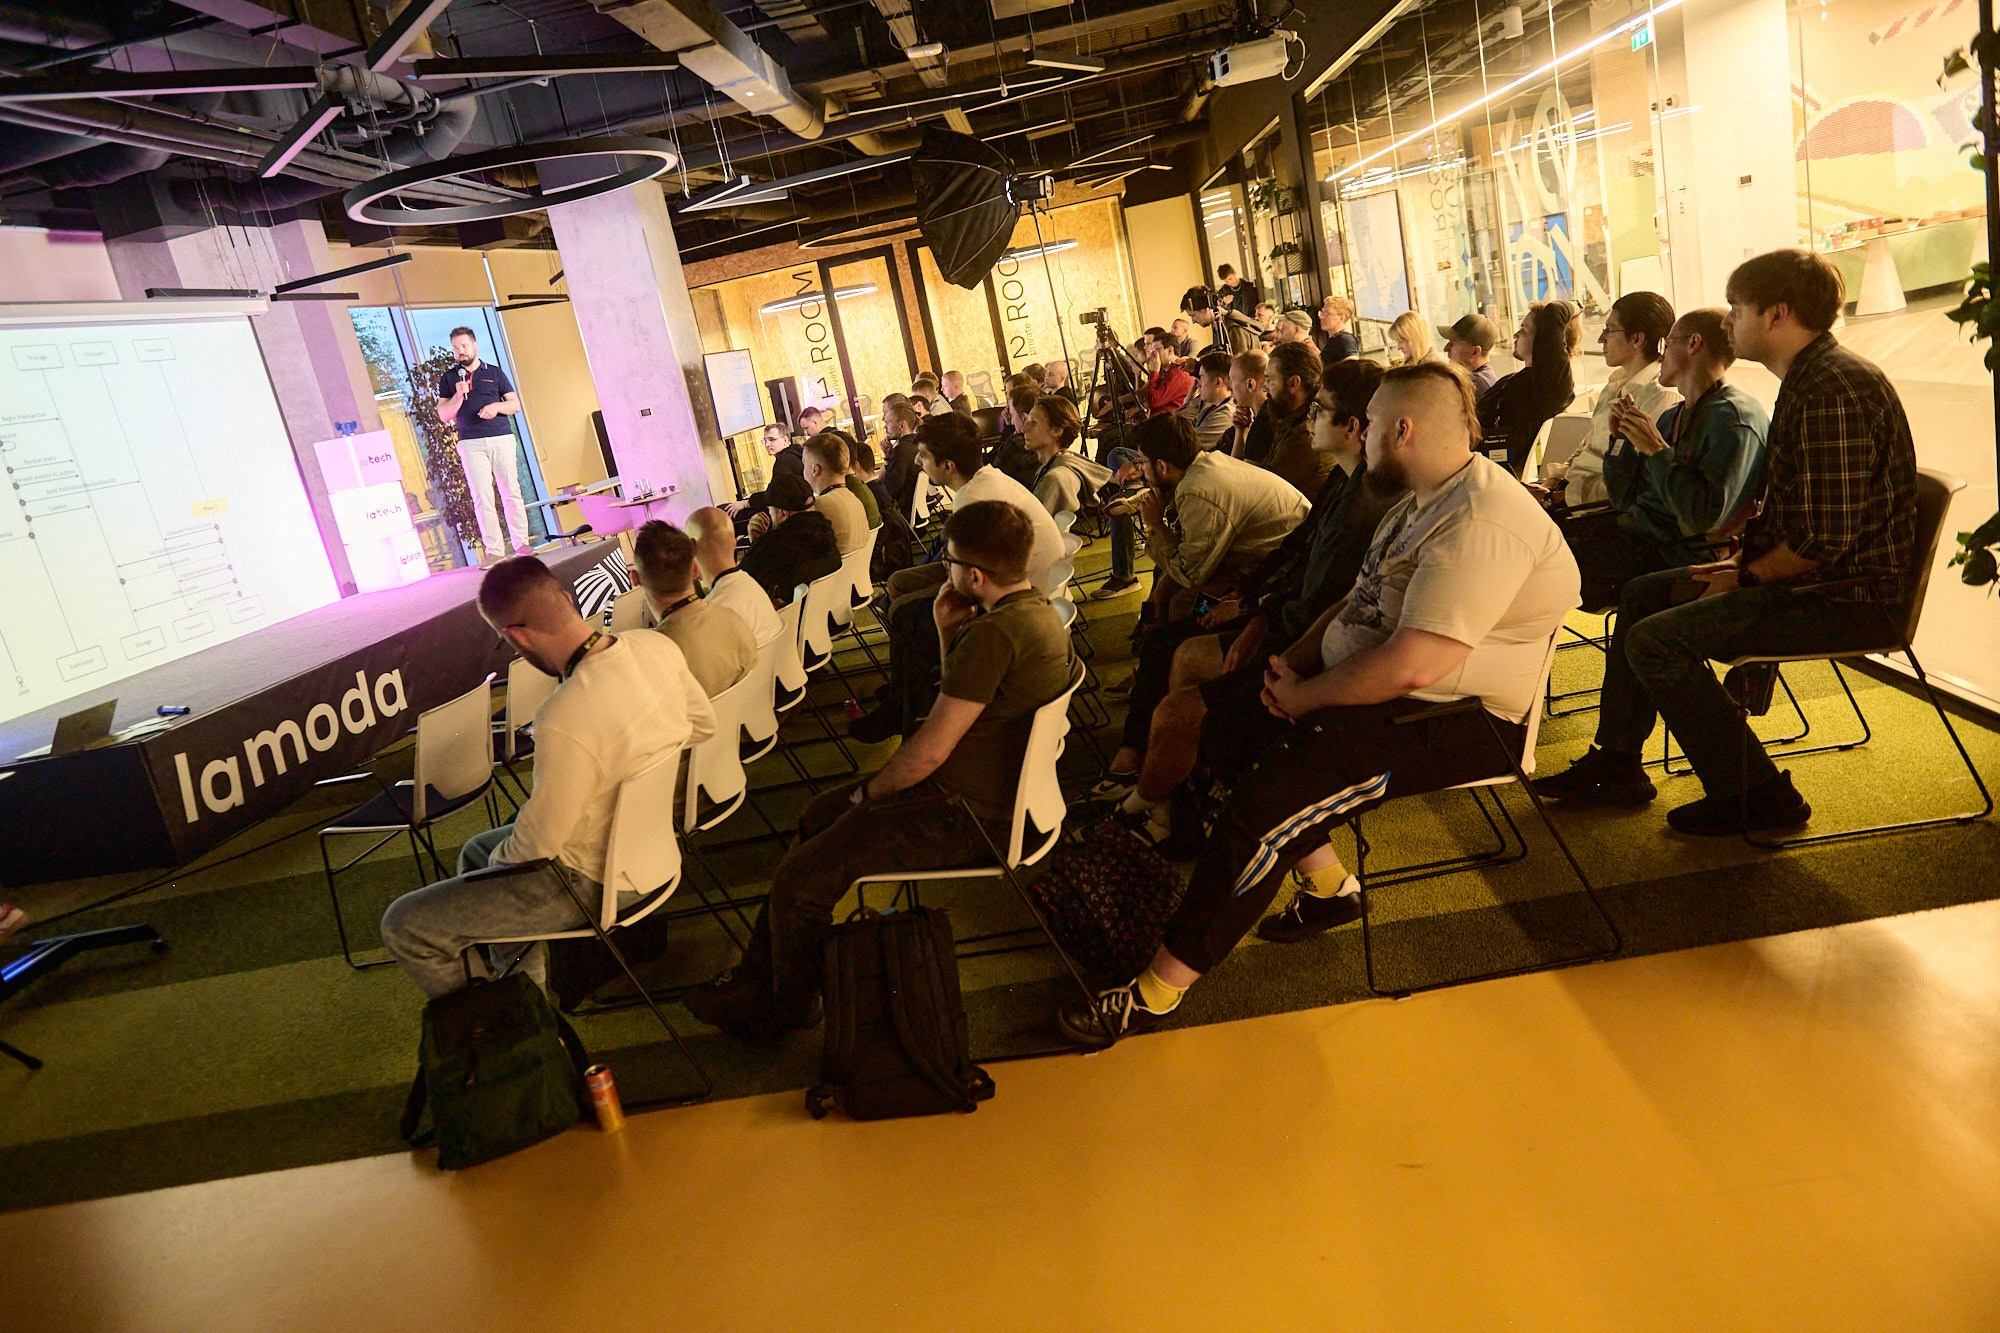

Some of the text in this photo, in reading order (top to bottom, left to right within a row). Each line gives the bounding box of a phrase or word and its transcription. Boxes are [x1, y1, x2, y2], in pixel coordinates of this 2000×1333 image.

[791, 270, 835, 399] 1 ROOM
[1010, 335, 1029, 359] 2
[366, 504, 402, 520] latech
[400, 551, 422, 566] latech
[174, 668, 409, 824] lamoda
